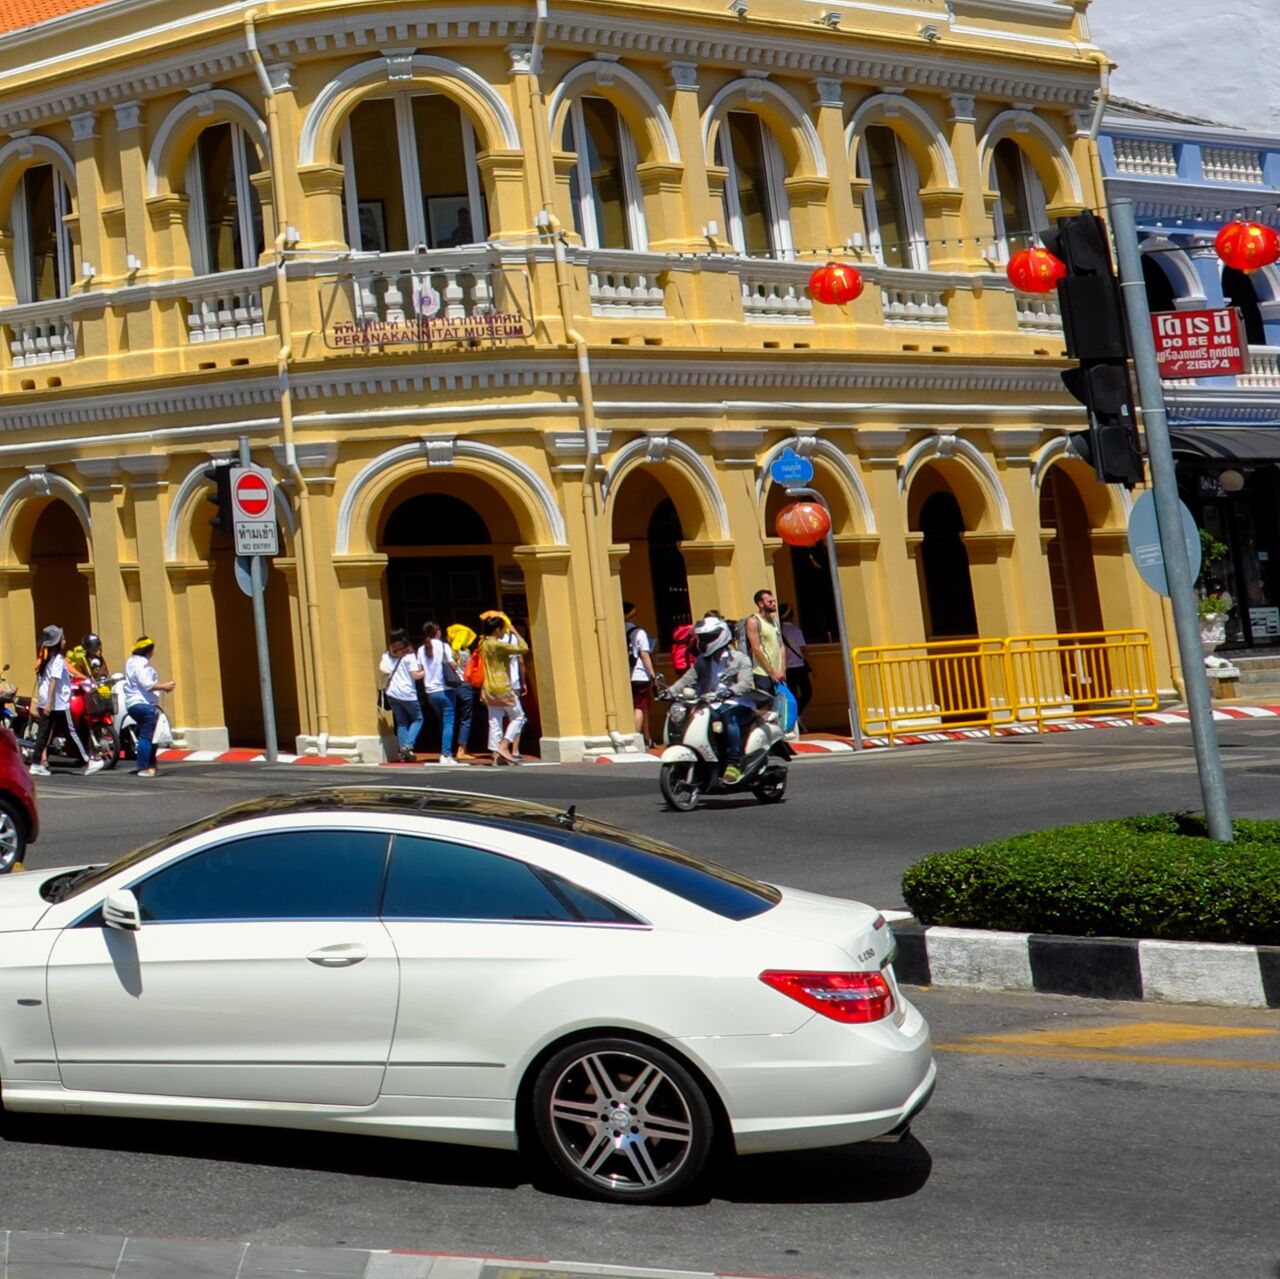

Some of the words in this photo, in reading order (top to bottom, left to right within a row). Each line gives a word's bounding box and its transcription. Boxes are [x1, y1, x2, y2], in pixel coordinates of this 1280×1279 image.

[464, 325, 524, 338] MUSEUM
[1162, 337, 1183, 348] DO
[1188, 336, 1209, 346] RE
[1213, 335, 1232, 345] MI
[1186, 359, 1231, 370] 215174
[238, 524, 274, 540] ห้ามเข้า
[242, 543, 251, 551] NO
[253, 543, 272, 551] ENTRY
